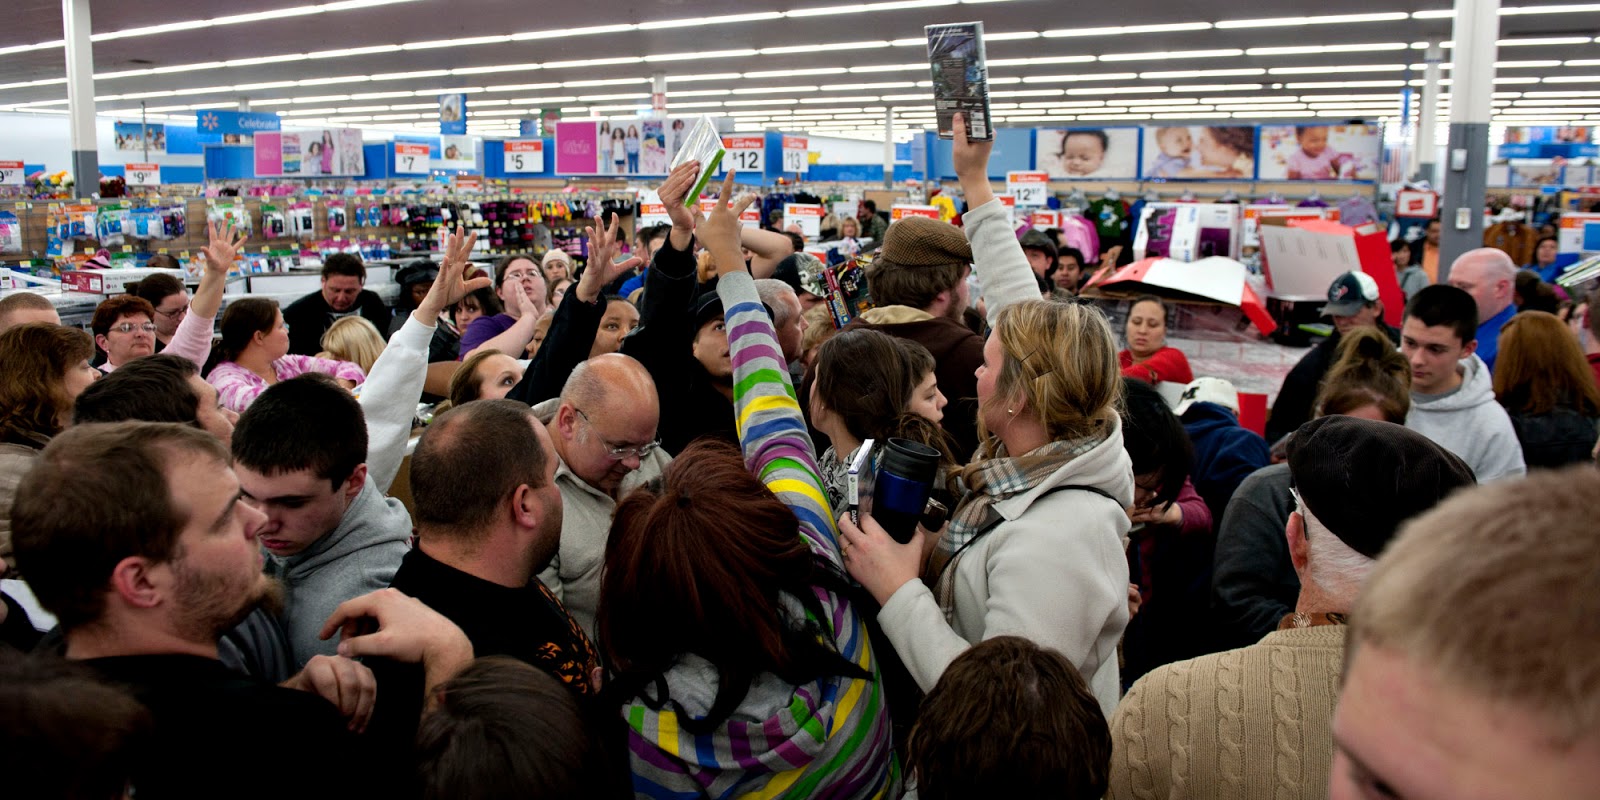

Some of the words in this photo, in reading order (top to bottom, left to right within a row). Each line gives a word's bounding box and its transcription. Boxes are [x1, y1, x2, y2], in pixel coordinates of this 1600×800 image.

[238, 117, 279, 129] Celebrate!
[402, 156, 414, 171] $7
[511, 154, 523, 170] $5
[732, 151, 759, 169] $12
